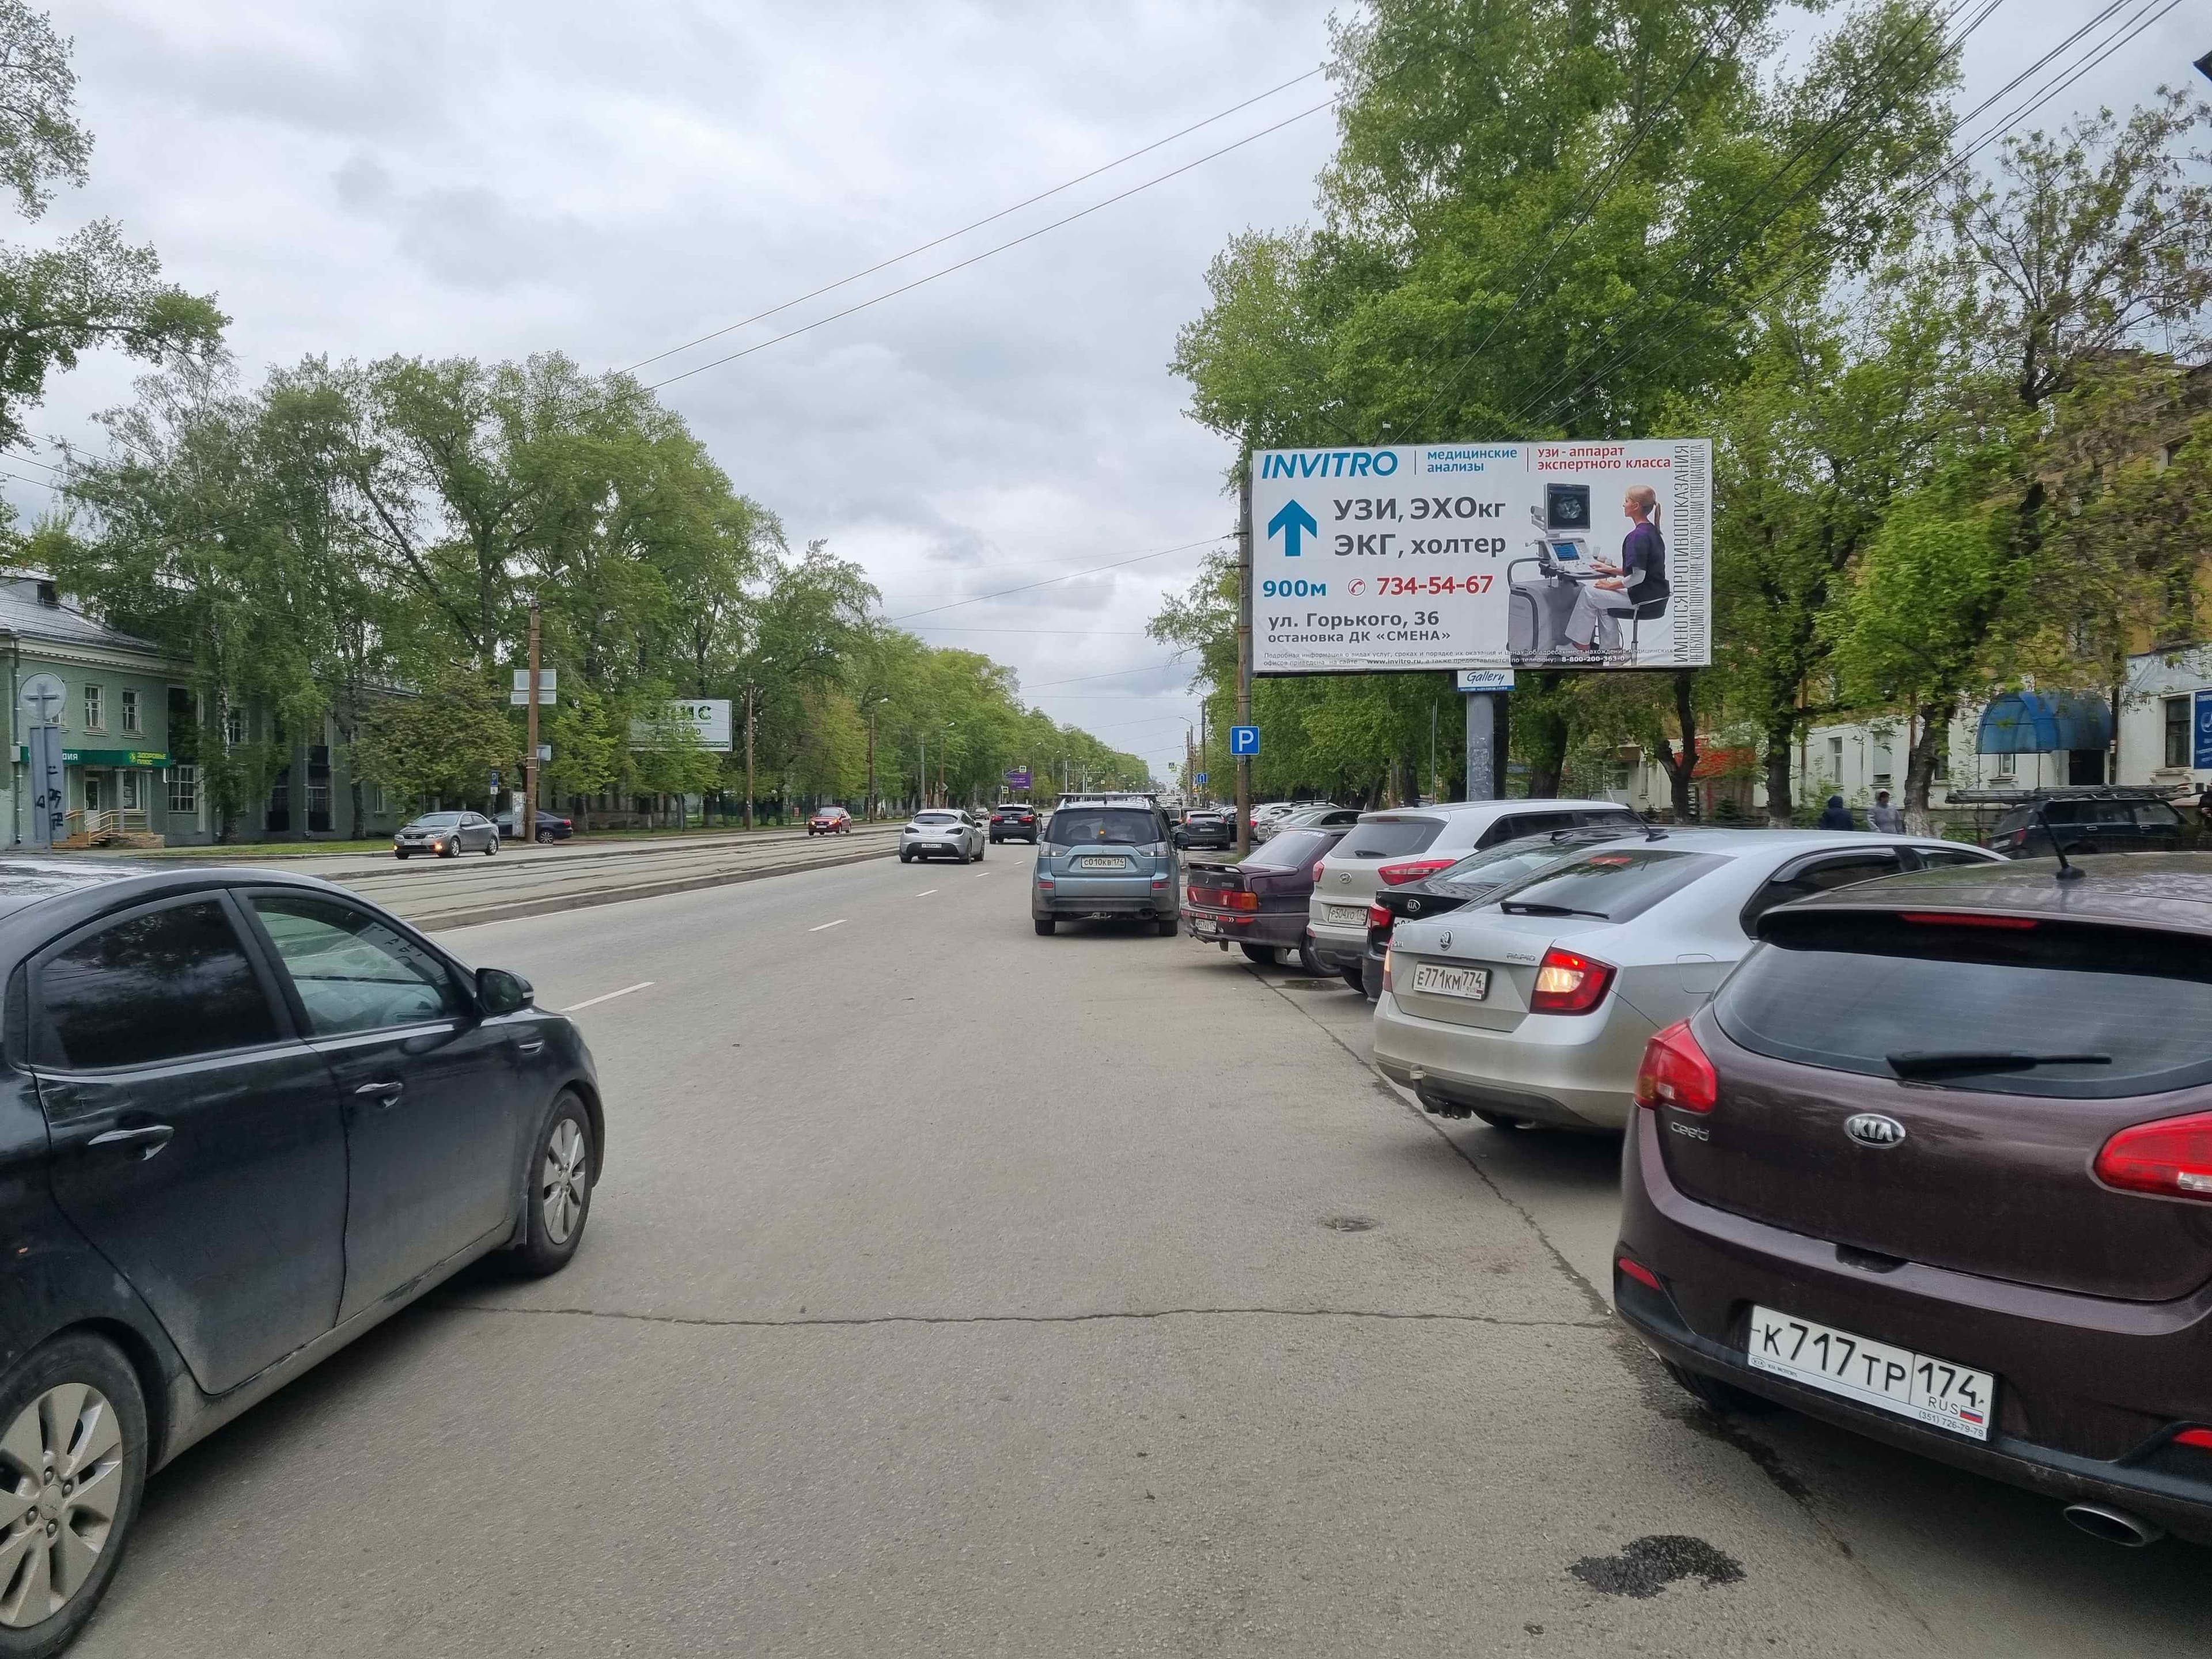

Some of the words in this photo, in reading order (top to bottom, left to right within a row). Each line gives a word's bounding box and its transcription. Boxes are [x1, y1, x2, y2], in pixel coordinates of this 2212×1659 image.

[1427, 448, 1518, 461] медицинские
[1570, 446, 1625, 459] аппарат
[1262, 451, 1399, 479] INVITRO
[1427, 461, 1484, 472] анализы
[1537, 459, 1622, 472] экспертного
[1626, 457, 1671, 468] класса
[1333, 498, 1404, 523] УЗИ,
[1410, 497, 1506, 519] ЭХОкг
[1690, 501, 1705, 559] КОНСУЛЬТАЦИИ
[1335, 534, 1404, 559] ЭКГ,
[1411, 537, 1506, 558] холтер
[1263, 580, 1327, 597] 900м
[1377, 575, 1493, 596] 734-54-67
[1690, 562, 1705, 606] ПОЛУЧЕНИЕ
[1268, 615, 1298, 630] ул.
[1306, 613, 1408, 630] Горького,
[1414, 611, 1440, 626] 36
[1268, 632, 1344, 643] остановка
[1349, 631, 1370, 643] ДК
[1376, 630, 1451, 642] «СМЕНА»
[1690, 609, 1705, 662] НЕОБХОДИМО
[1467, 671, 1505, 685] Gallery
[1238, 730, 1254, 752] P
[1417, 967, 1461, 990] Е771КМ
[1463, 971, 1482, 987] 774
[1853, 1118, 1895, 1142] KIA
[1763, 1322, 1906, 1392] К717ТР
[1918, 1362, 1977, 1407] 174
[1928, 1396, 1959, 1415] RUS
[1919, 1410, 1940, 1425] (351)
[1942, 1418, 1984, 1438] 726-79-79
